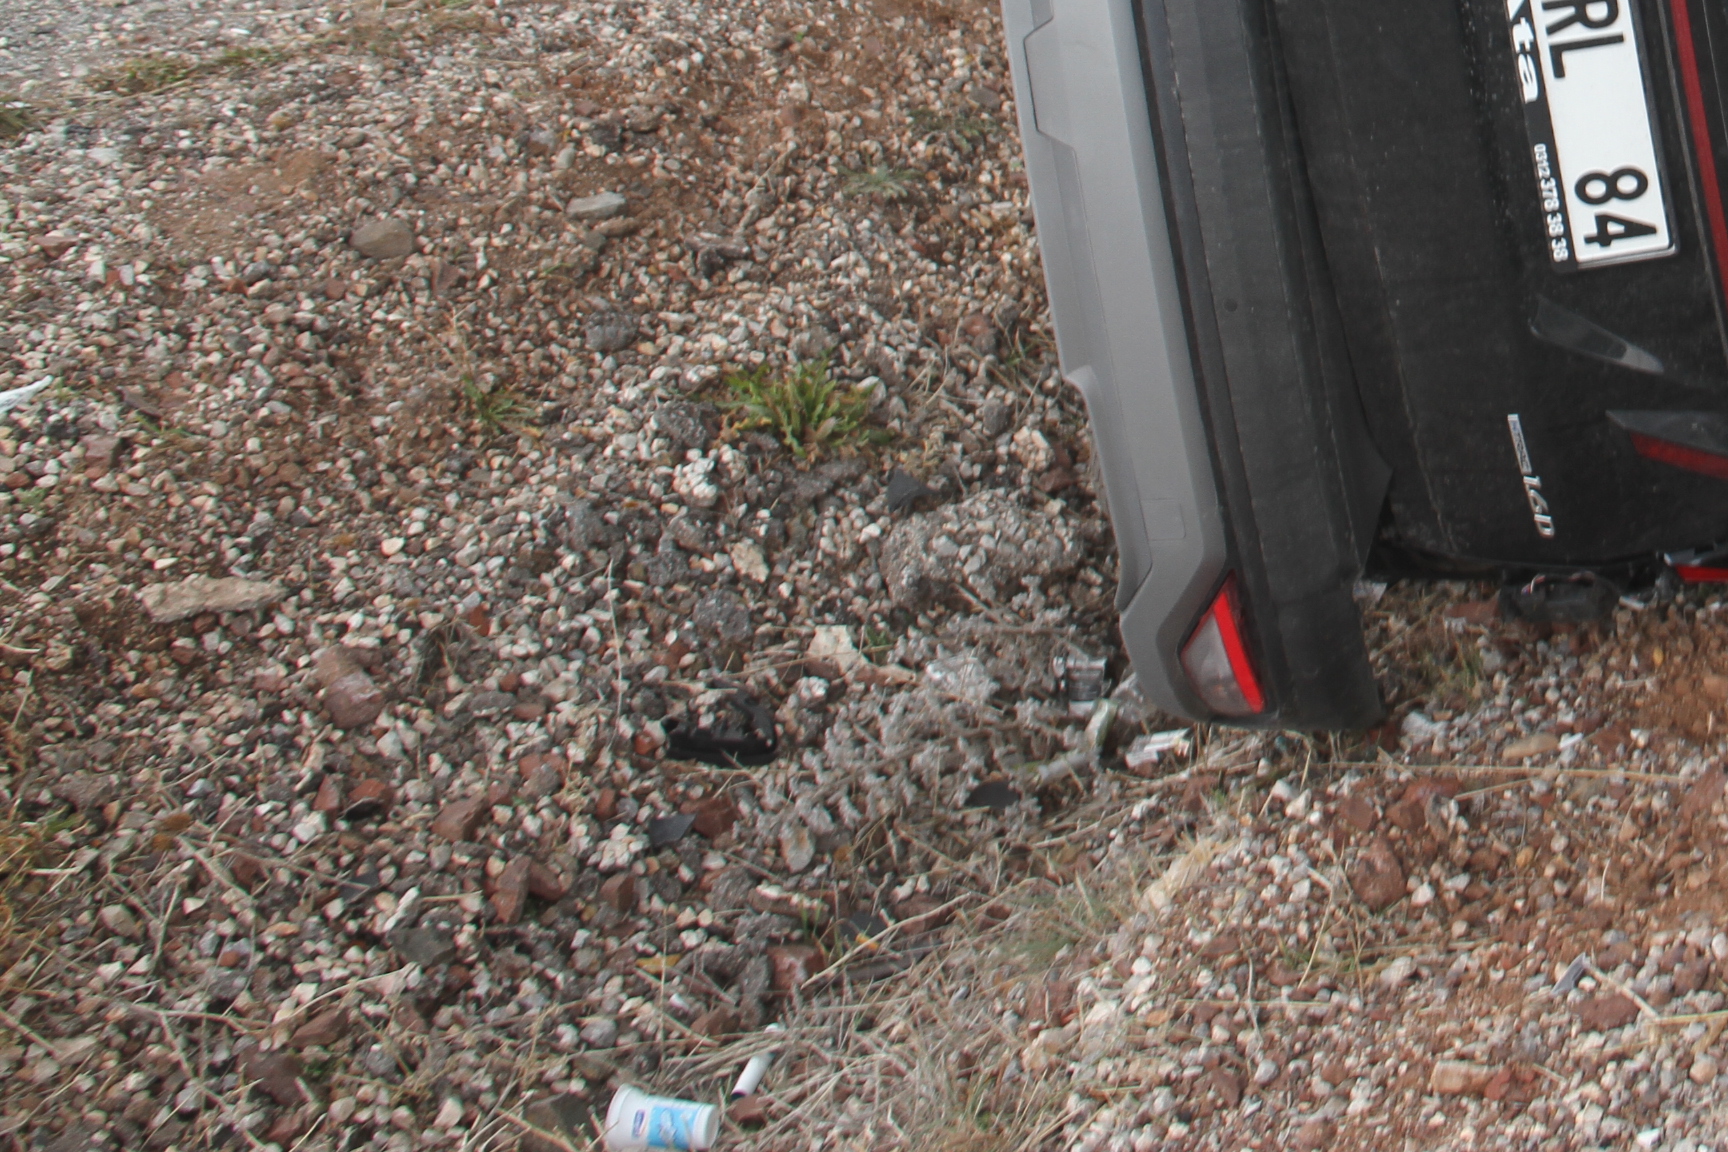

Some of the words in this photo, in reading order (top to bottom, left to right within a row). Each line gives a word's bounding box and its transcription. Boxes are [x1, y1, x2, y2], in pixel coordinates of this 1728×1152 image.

[1533, 143, 1551, 179] 0312
[1539, 176, 1560, 212] 378
[1574, 166, 1658, 247] 84
[1546, 212, 1565, 237] 38
[1551, 237, 1569, 262] 38
